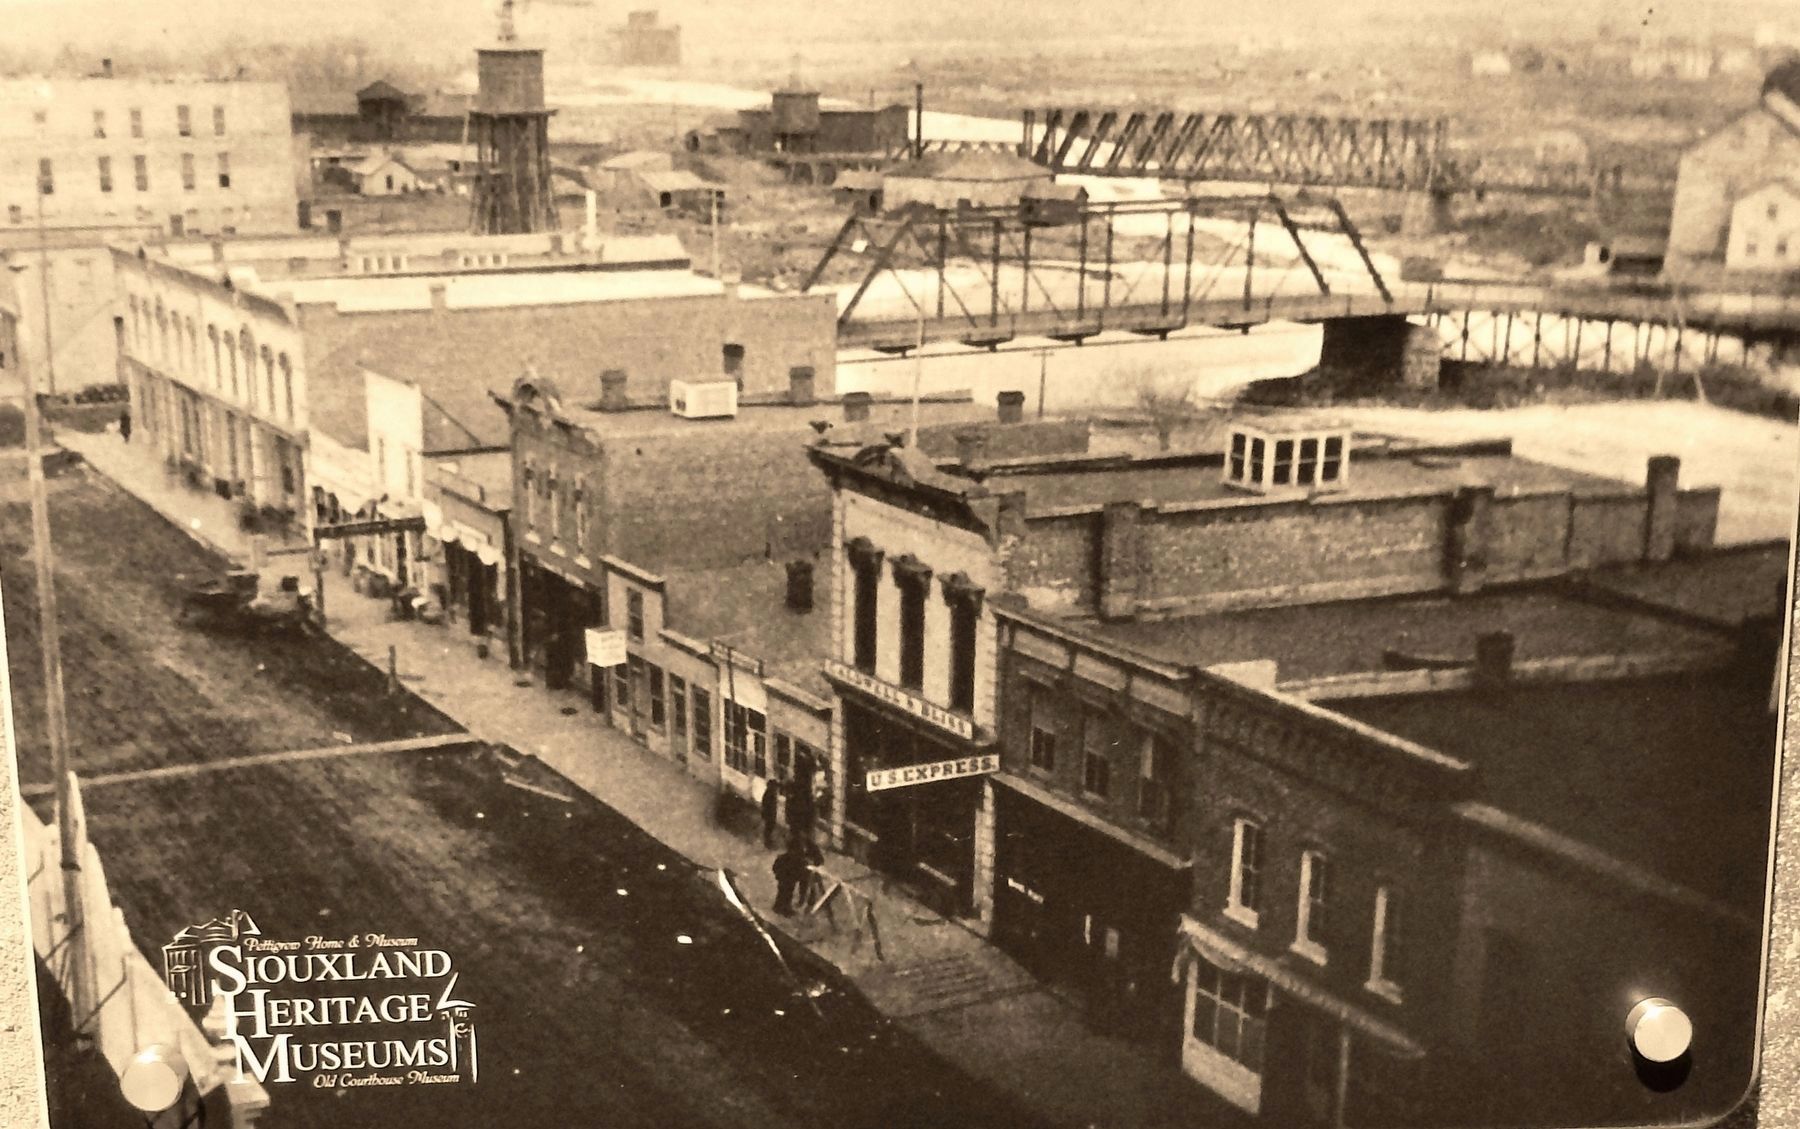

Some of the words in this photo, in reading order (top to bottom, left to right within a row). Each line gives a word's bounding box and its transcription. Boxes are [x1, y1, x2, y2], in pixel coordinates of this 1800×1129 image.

[243, 937, 301, 953] Pettigrew
[304, 935, 344, 950] Home
[348, 934, 360, 948] &
[365, 933, 418, 948] Museum
[208, 945, 452, 996] SIOUXLAND
[221, 988, 432, 1039] HERITAGE
[231, 1033, 448, 1085] MUSEUMS
[313, 1074, 337, 1088] Old
[340, 1073, 404, 1088] Courthouse
[407, 1070, 460, 1085] Museum
